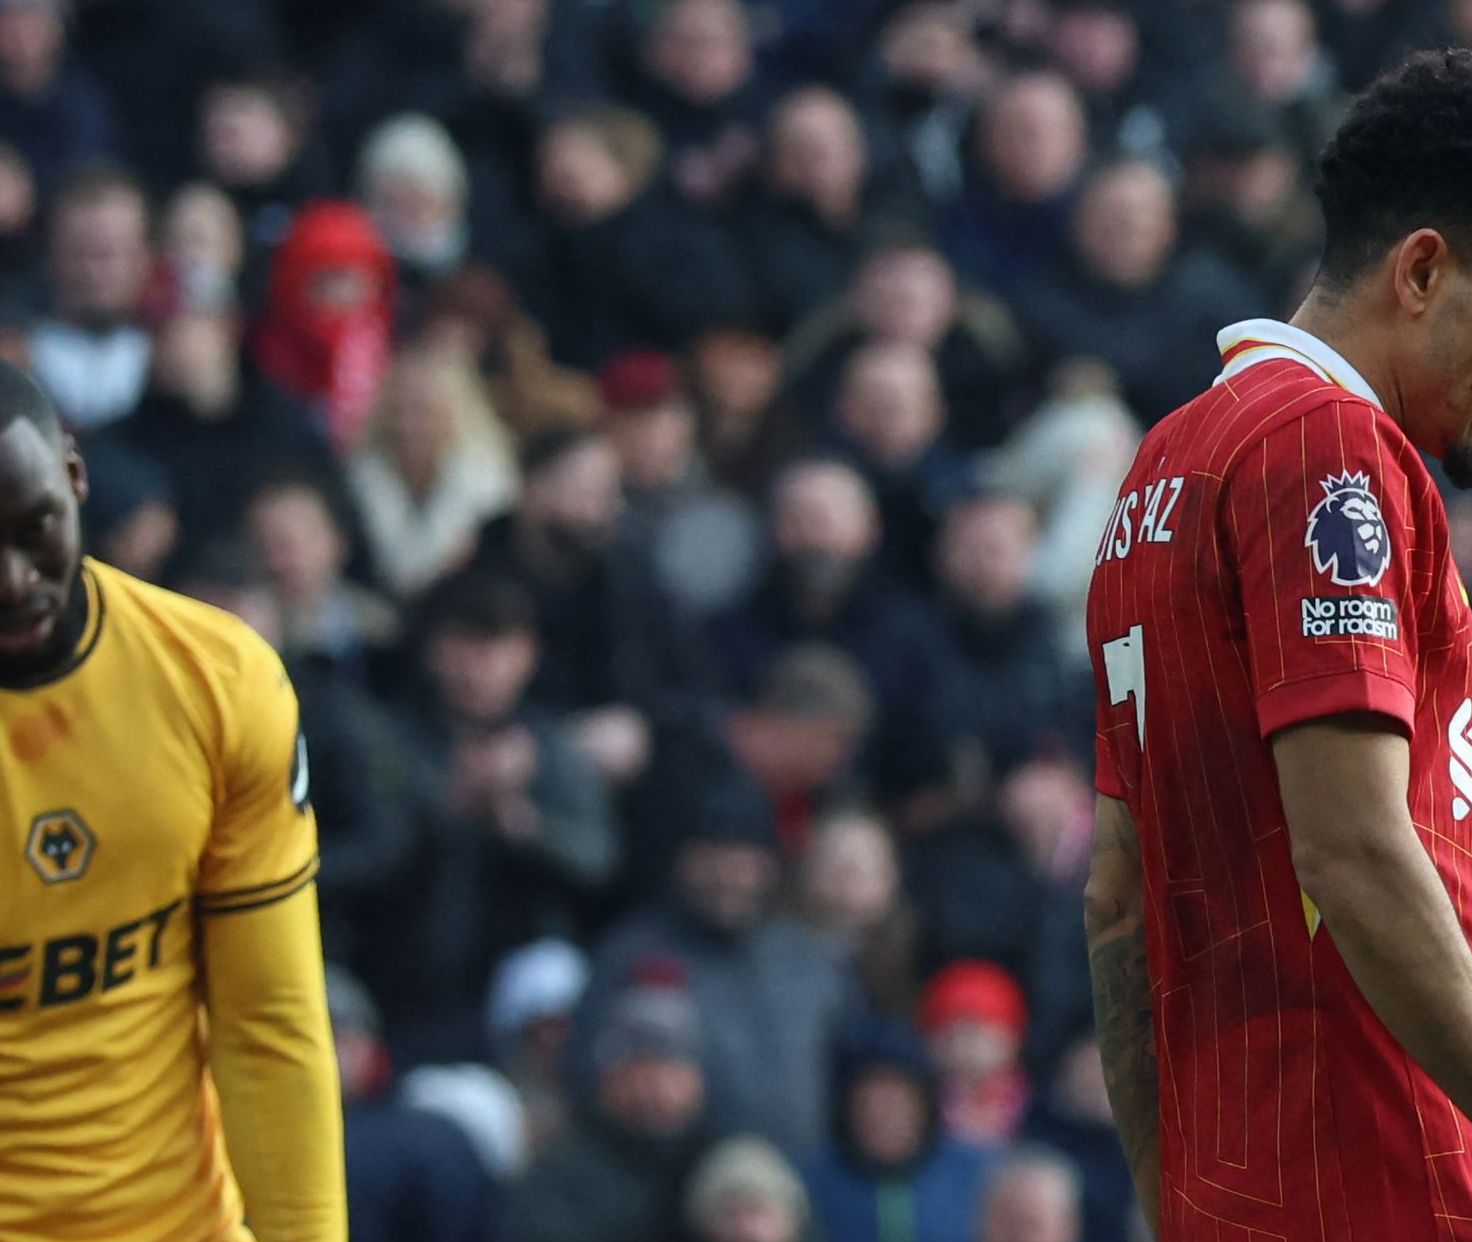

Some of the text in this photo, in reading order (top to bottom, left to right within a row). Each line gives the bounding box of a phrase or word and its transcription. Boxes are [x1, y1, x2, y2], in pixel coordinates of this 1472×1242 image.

[1301, 598, 1391, 620] No room
[1302, 616, 1335, 637] for
